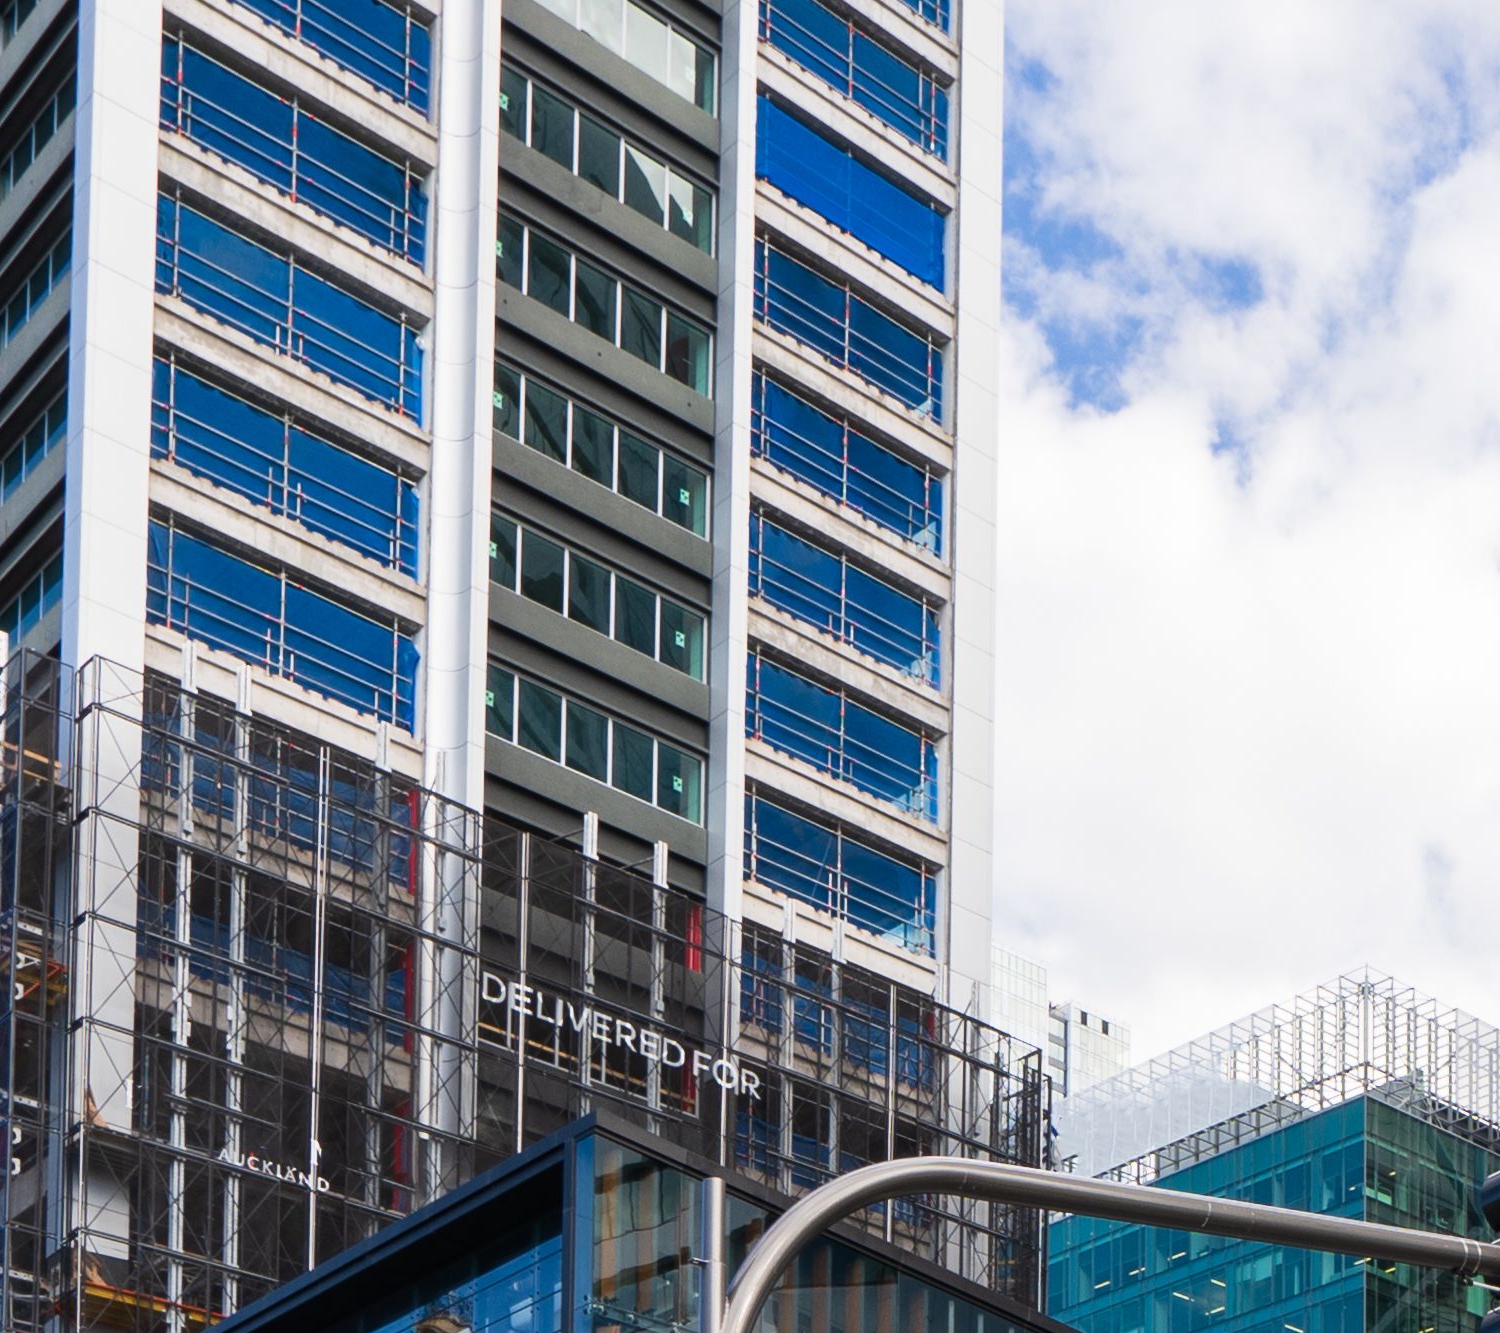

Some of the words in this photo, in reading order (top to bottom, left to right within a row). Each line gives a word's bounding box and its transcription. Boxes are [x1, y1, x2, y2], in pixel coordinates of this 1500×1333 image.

[481, 970, 686, 1067] DELIVERED
[692, 1049, 762, 1100] FOR
[217, 1148, 331, 1193] AUCKLAND
